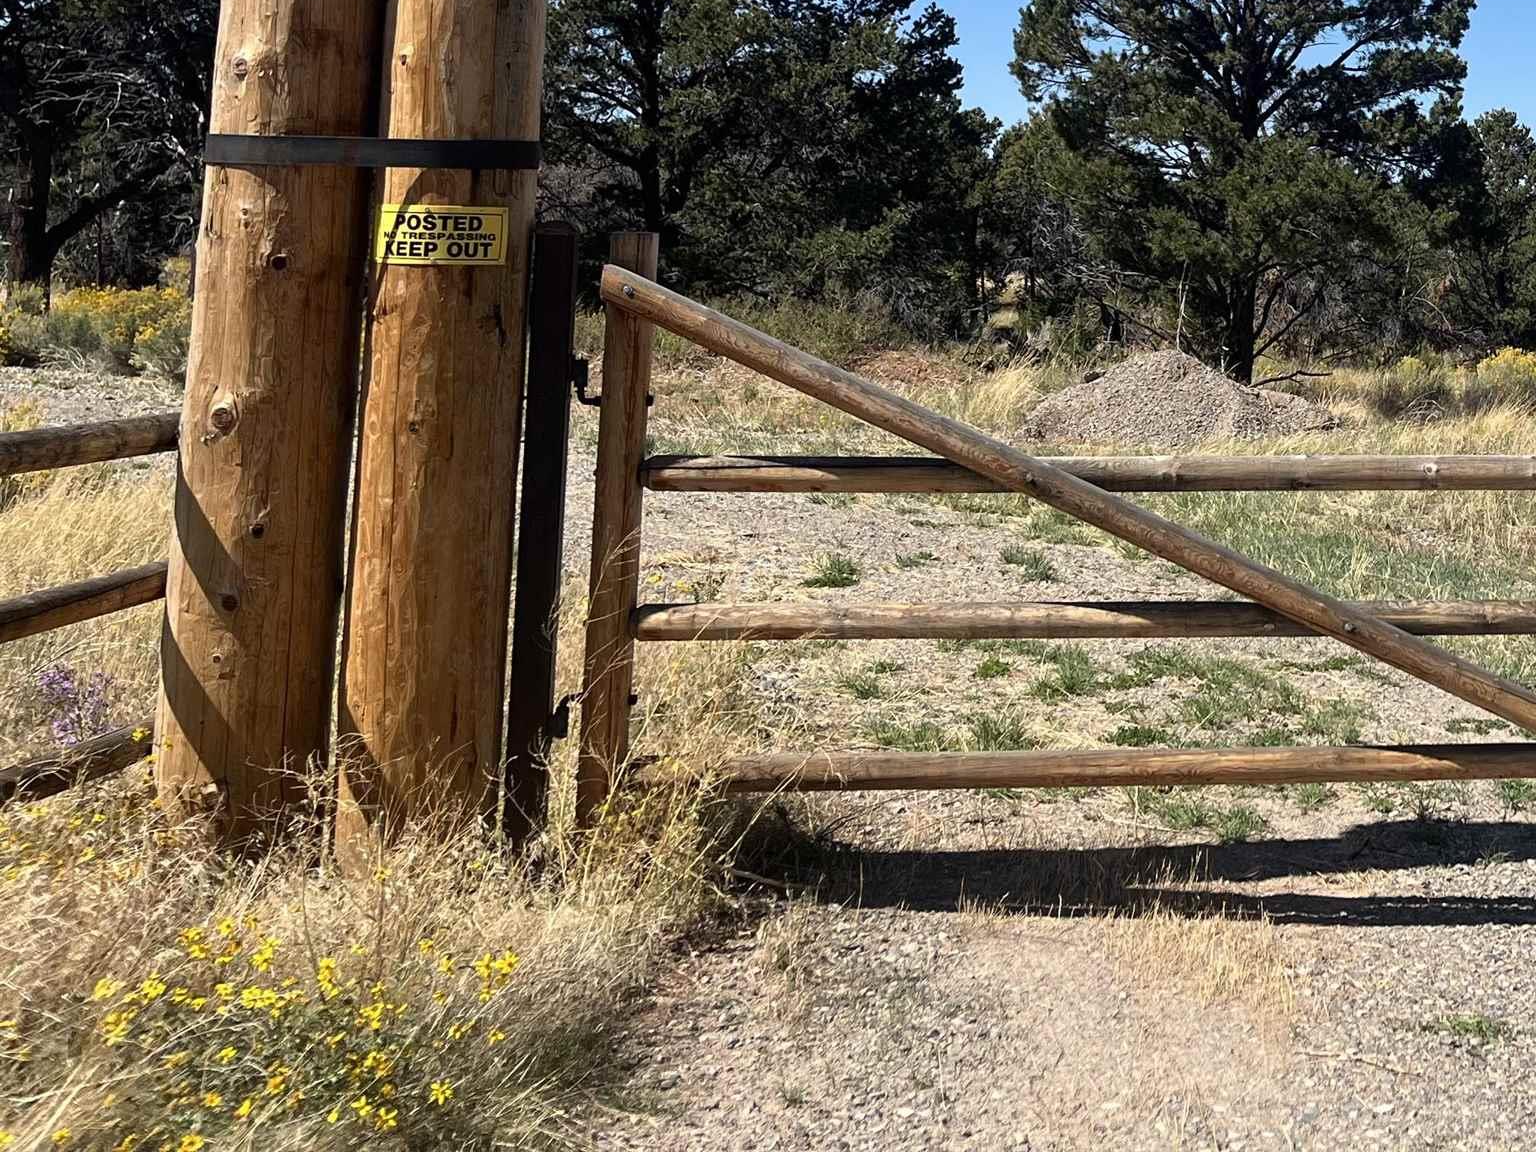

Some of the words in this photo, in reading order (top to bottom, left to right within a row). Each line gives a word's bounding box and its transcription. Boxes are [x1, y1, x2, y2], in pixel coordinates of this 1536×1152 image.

[394, 214, 482, 231] POSTED
[384, 231, 397, 239] NO
[401, 232, 496, 241] TRESPASSING
[385, 240, 438, 257] KEEP
[446, 242, 493, 258] OUT
